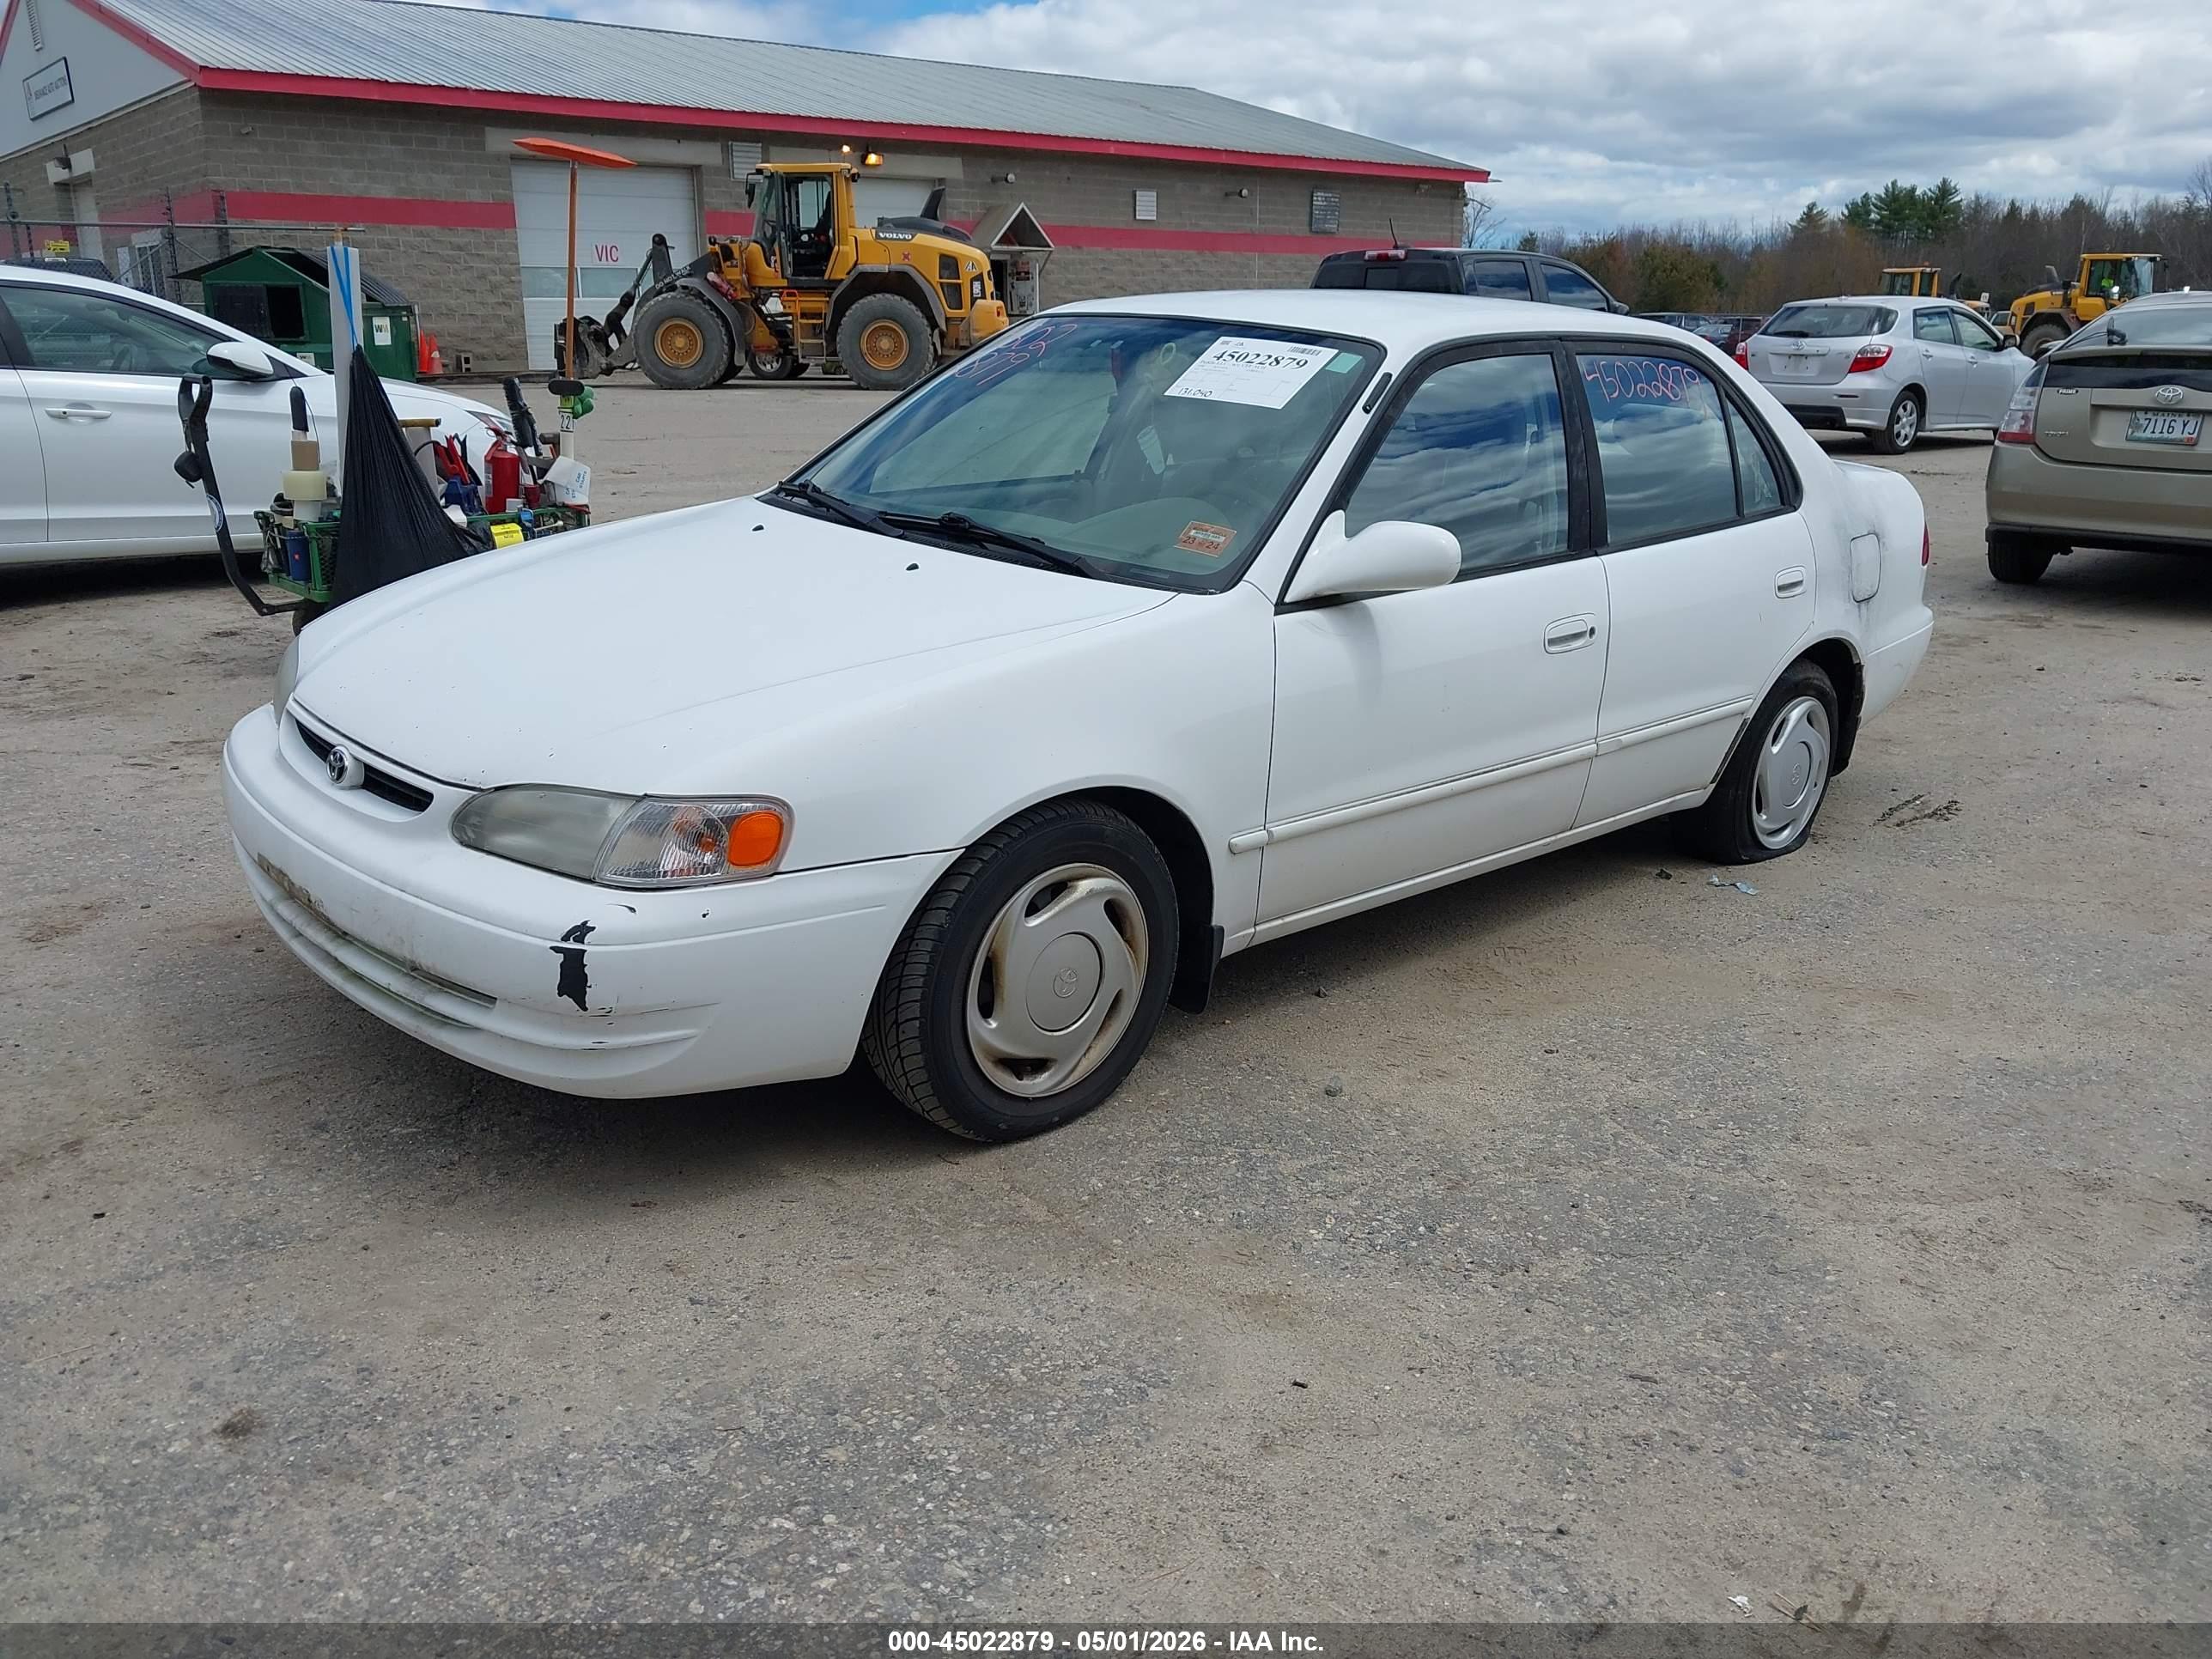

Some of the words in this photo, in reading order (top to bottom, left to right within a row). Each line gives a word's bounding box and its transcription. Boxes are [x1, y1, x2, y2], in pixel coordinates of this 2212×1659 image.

[595, 245, 618, 262] VIC
[1212, 349, 1309, 370] 45022879
[1582, 361, 1703, 408] 45022879
[2143, 417, 2177, 434] 7116
[2181, 420, 2198, 435] YJ
